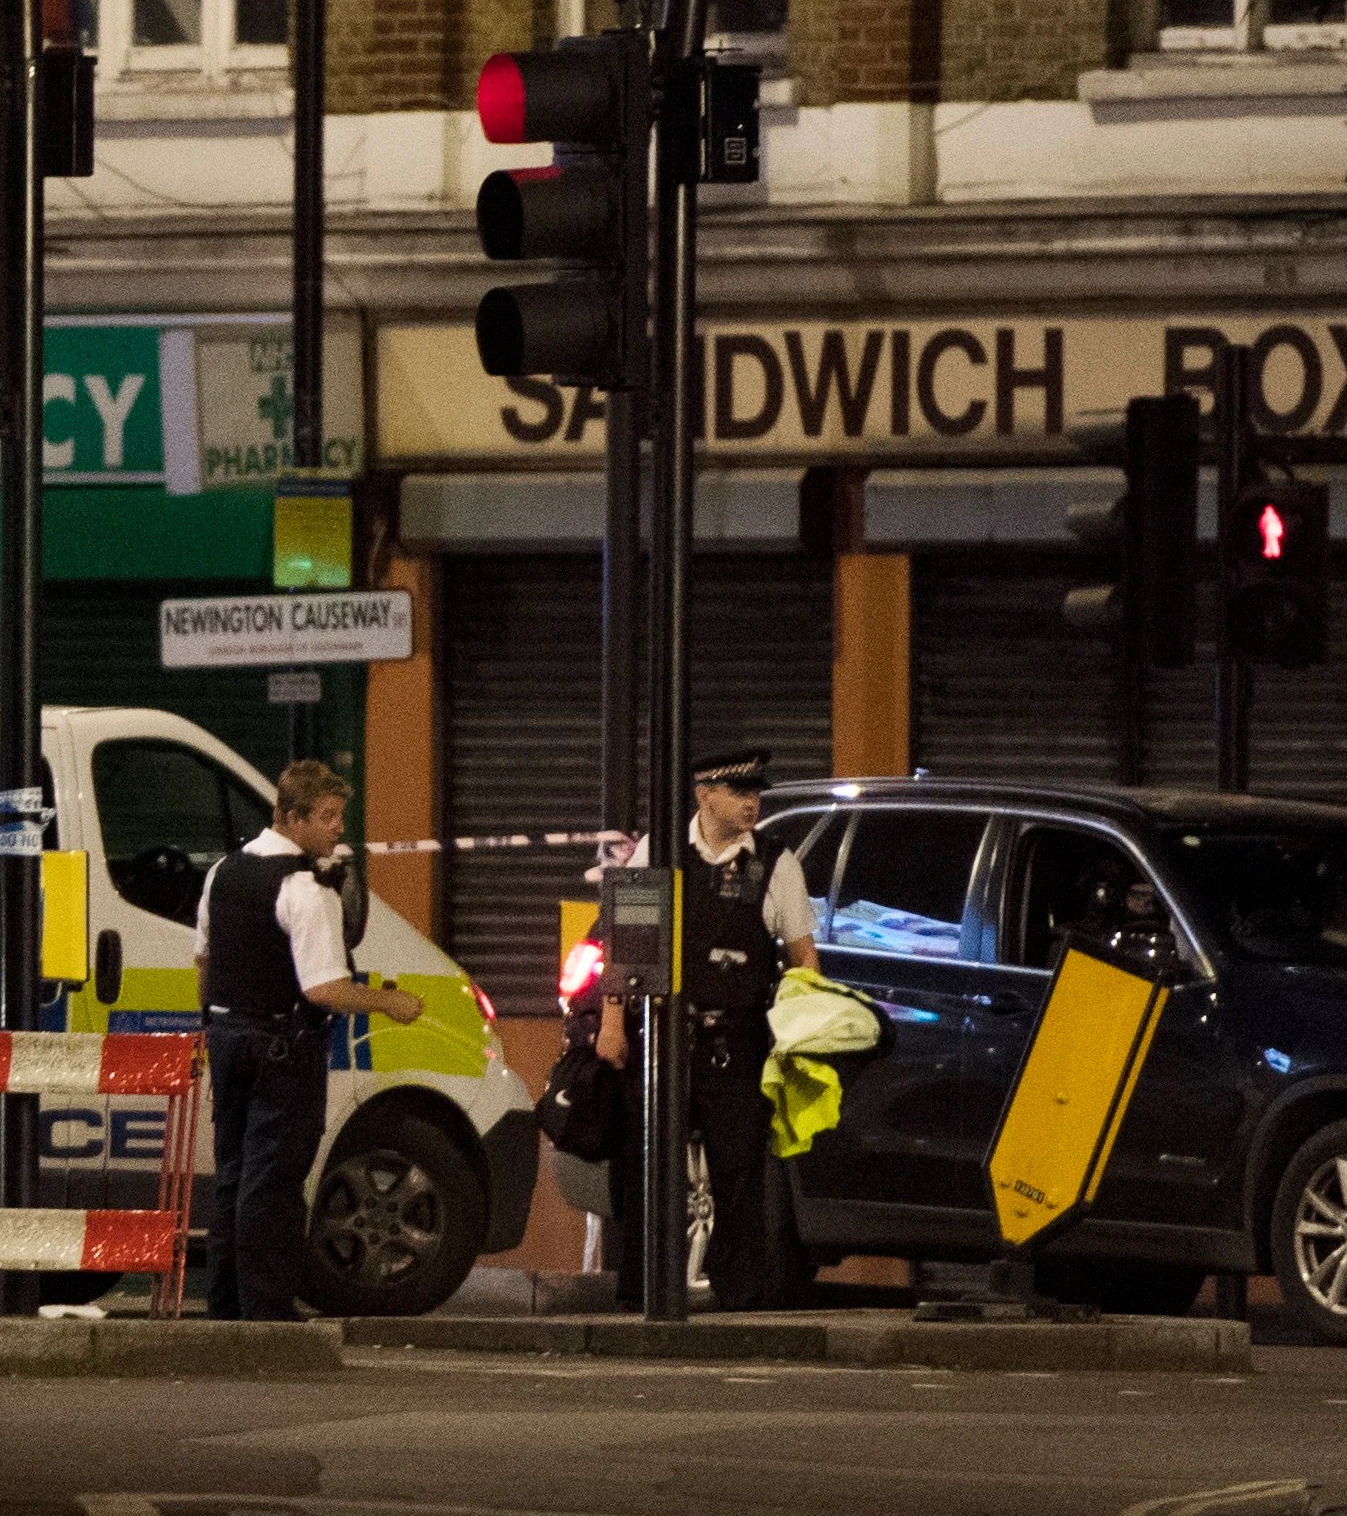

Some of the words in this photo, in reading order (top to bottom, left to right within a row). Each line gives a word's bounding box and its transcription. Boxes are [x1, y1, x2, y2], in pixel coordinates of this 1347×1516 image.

[500, 328, 1064, 442] SDWICH
[164, 603, 284, 635] NEWINGTON
[291, 600, 392, 631] CAUSEWAY
